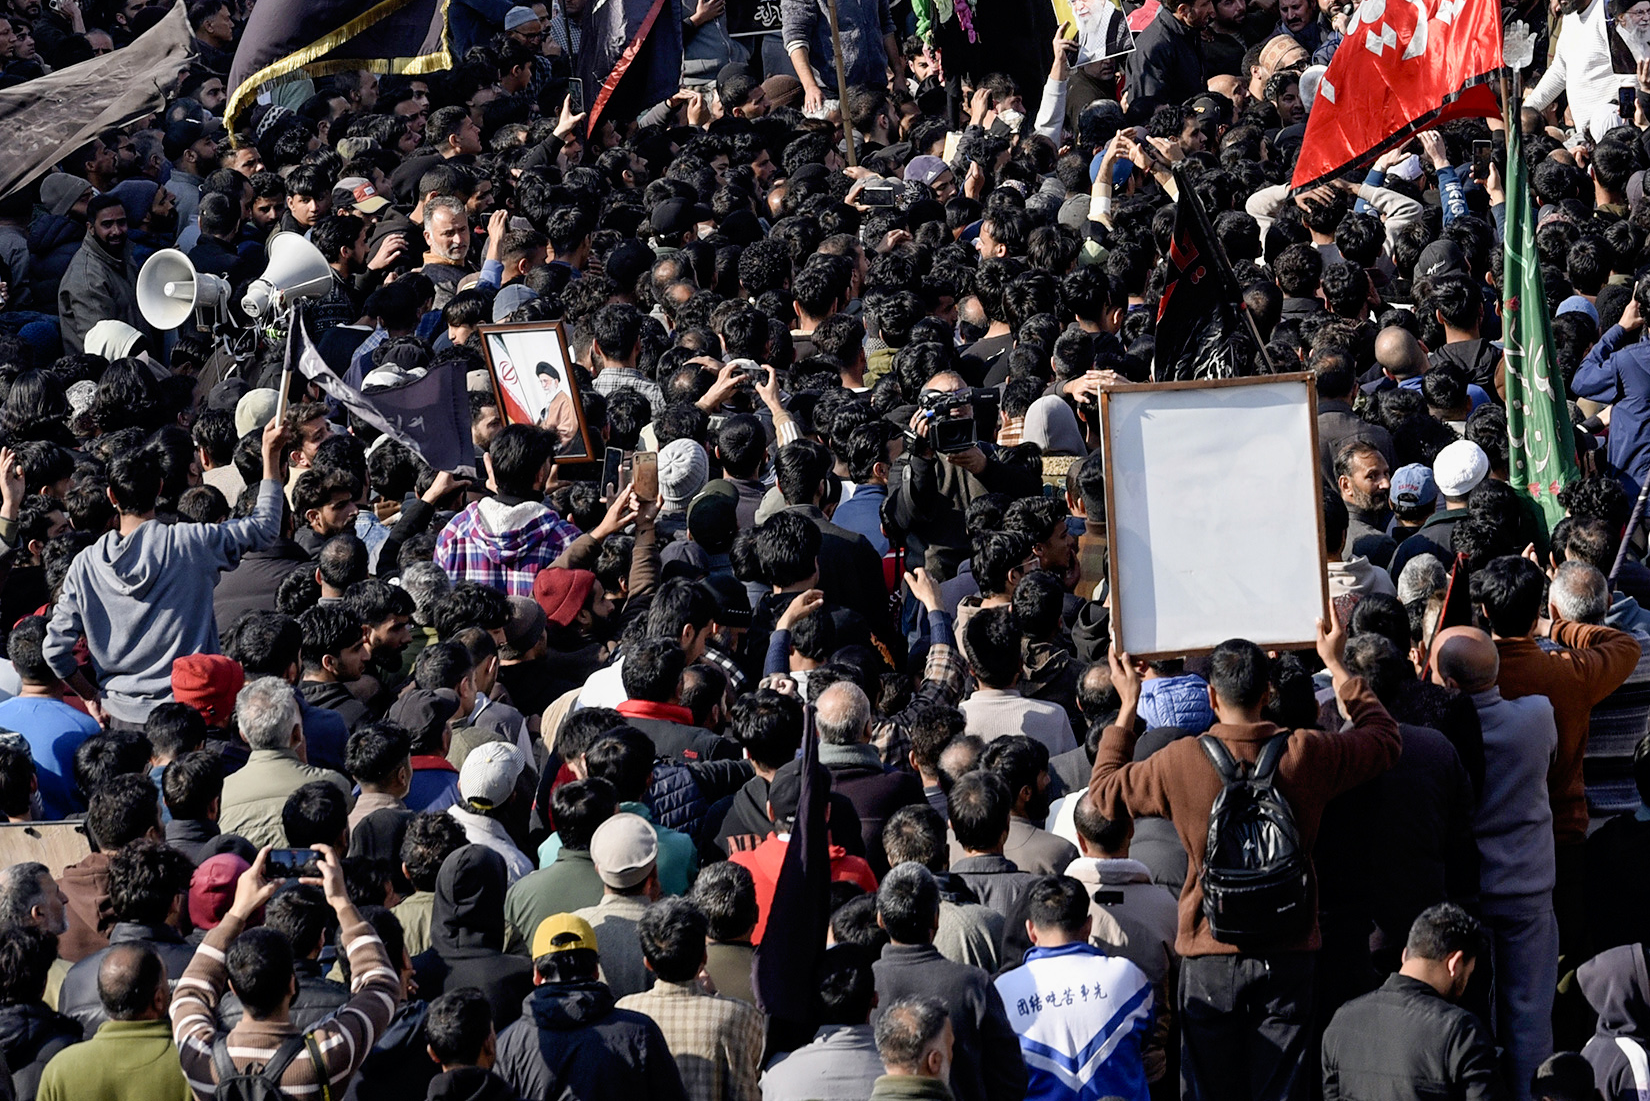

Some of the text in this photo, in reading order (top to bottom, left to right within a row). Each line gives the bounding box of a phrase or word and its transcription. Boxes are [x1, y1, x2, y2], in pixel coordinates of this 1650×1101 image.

[1017, 981, 1109, 1017] 团结吃苦争先
